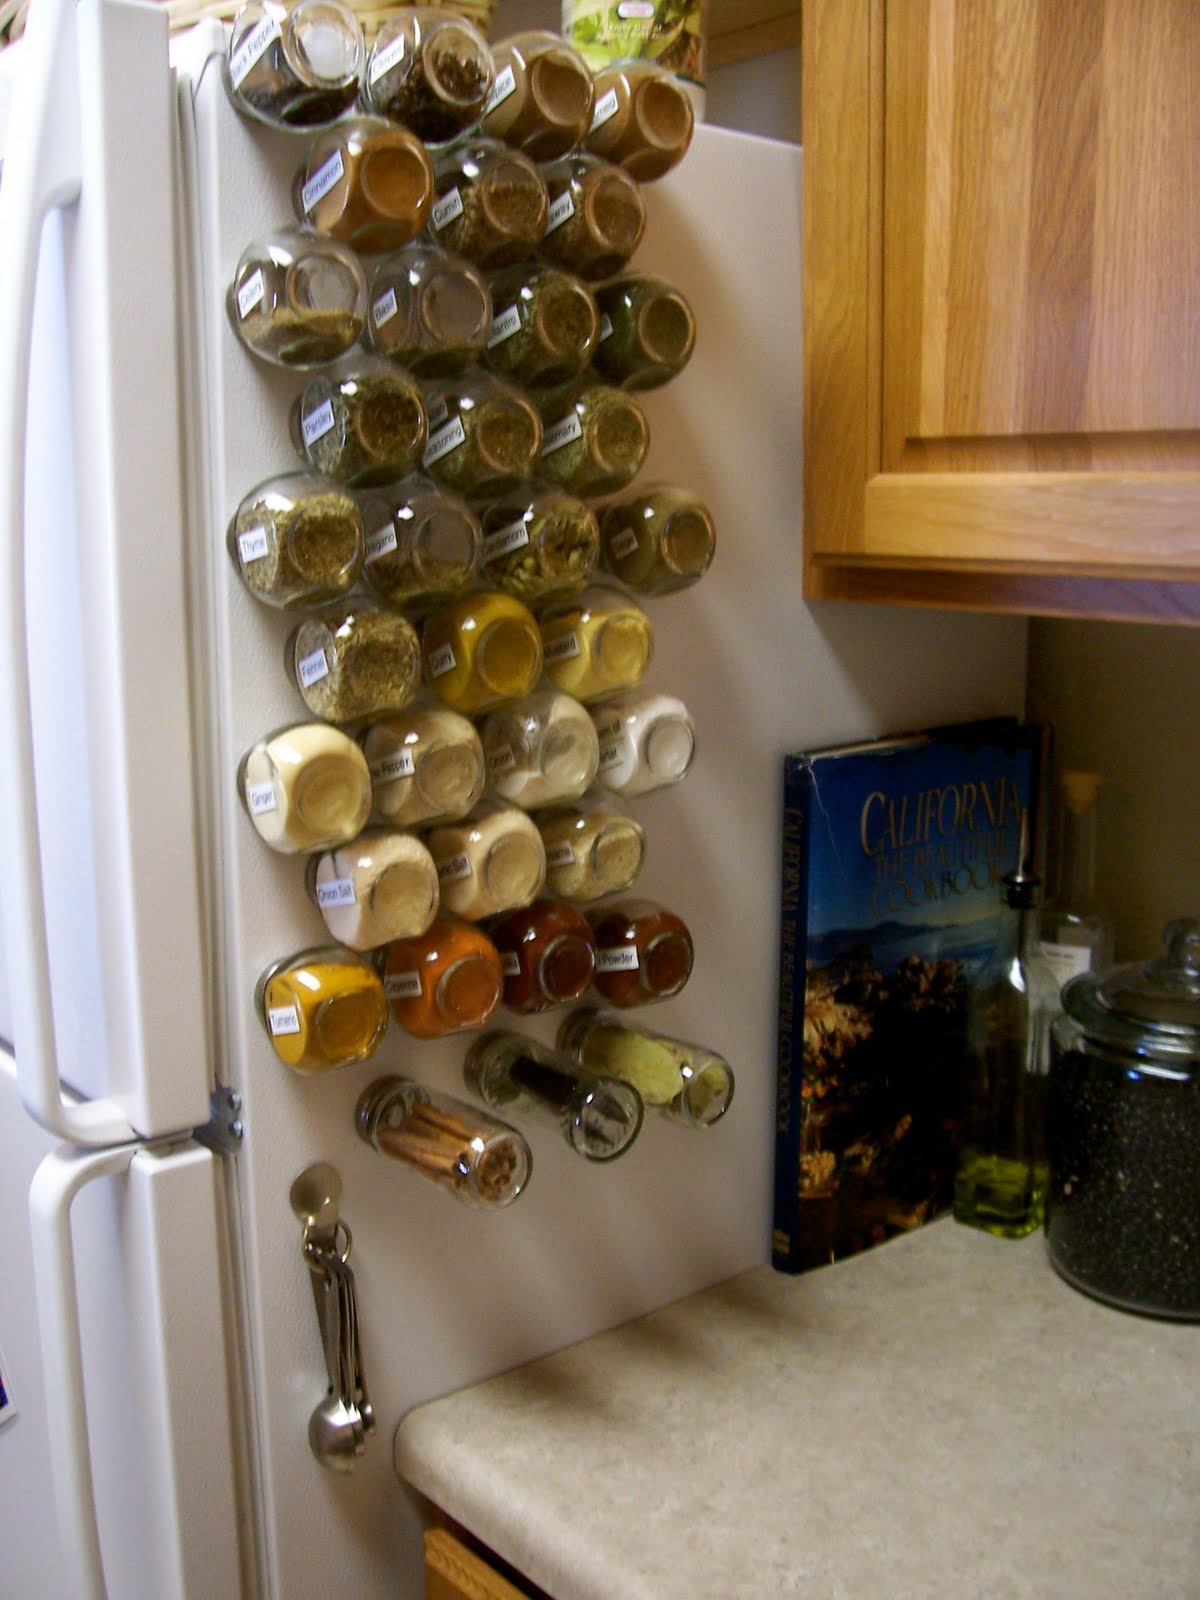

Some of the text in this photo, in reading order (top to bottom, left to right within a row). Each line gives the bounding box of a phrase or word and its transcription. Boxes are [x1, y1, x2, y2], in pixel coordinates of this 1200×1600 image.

[247, 18, 276, 54] Pepper
[595, 97, 617, 119] meg
[303, 158, 343, 203] Cinnamon
[433, 197, 461, 220] Cumin
[374, 294, 394, 321] Basil
[304, 410, 333, 438] Parsley
[426, 425, 463, 459] easoning
[242, 536, 266, 552] Thyme
[301, 654, 326, 677] Fennel
[251, 790, 273, 807] Ginger
[860, 776, 1022, 857] CALIFORNIA
[317, 882, 353, 902] Onion Salt
[602, 949, 633, 966] Powder
